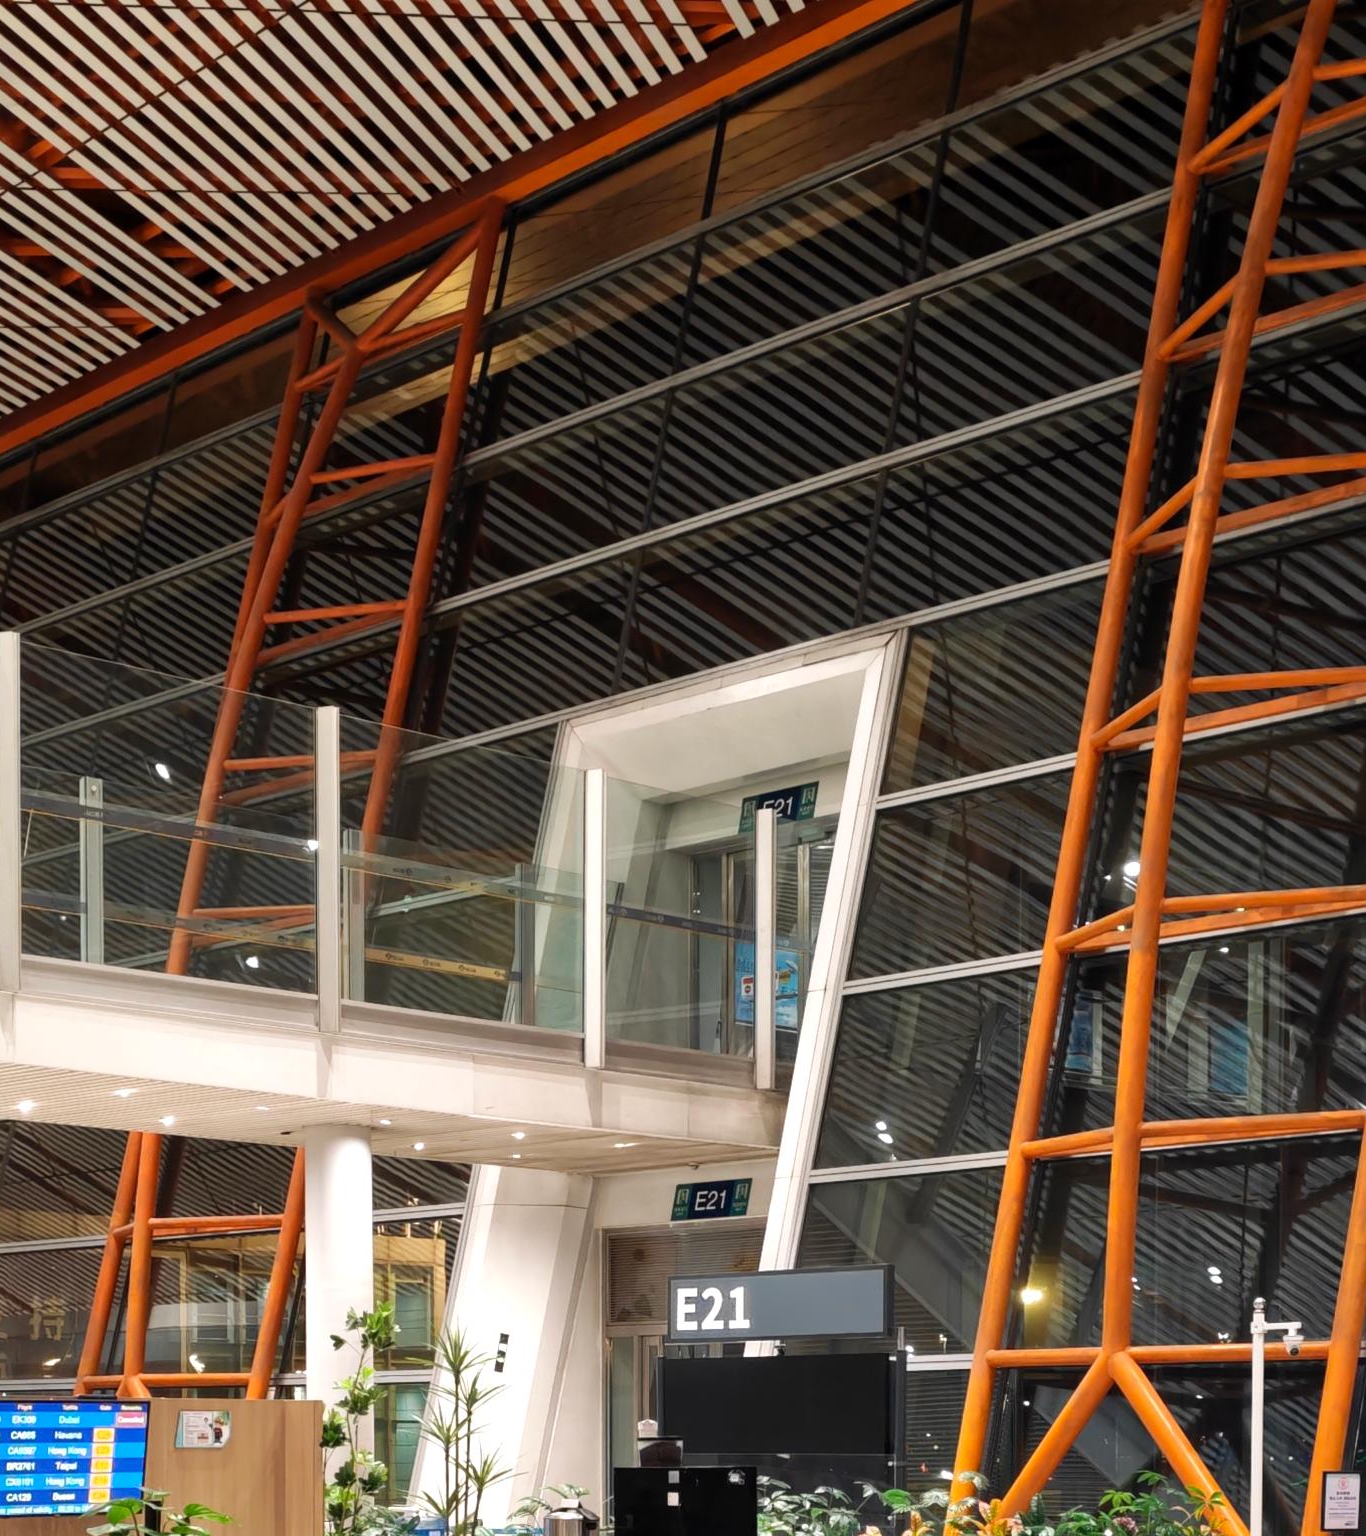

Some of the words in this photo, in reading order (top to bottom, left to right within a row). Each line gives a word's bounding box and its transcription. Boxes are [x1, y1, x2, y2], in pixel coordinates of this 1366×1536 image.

[695, 1189, 727, 1211] E21
[676, 1286, 751, 1331] E21
[59, 1415, 80, 1424] Dubai
[48, 1446, 67, 1456] Hong
[68, 1446, 87, 1456] Kong
[46, 1477, 64, 1486] Hong
[66, 1477, 85, 1486] Kong
